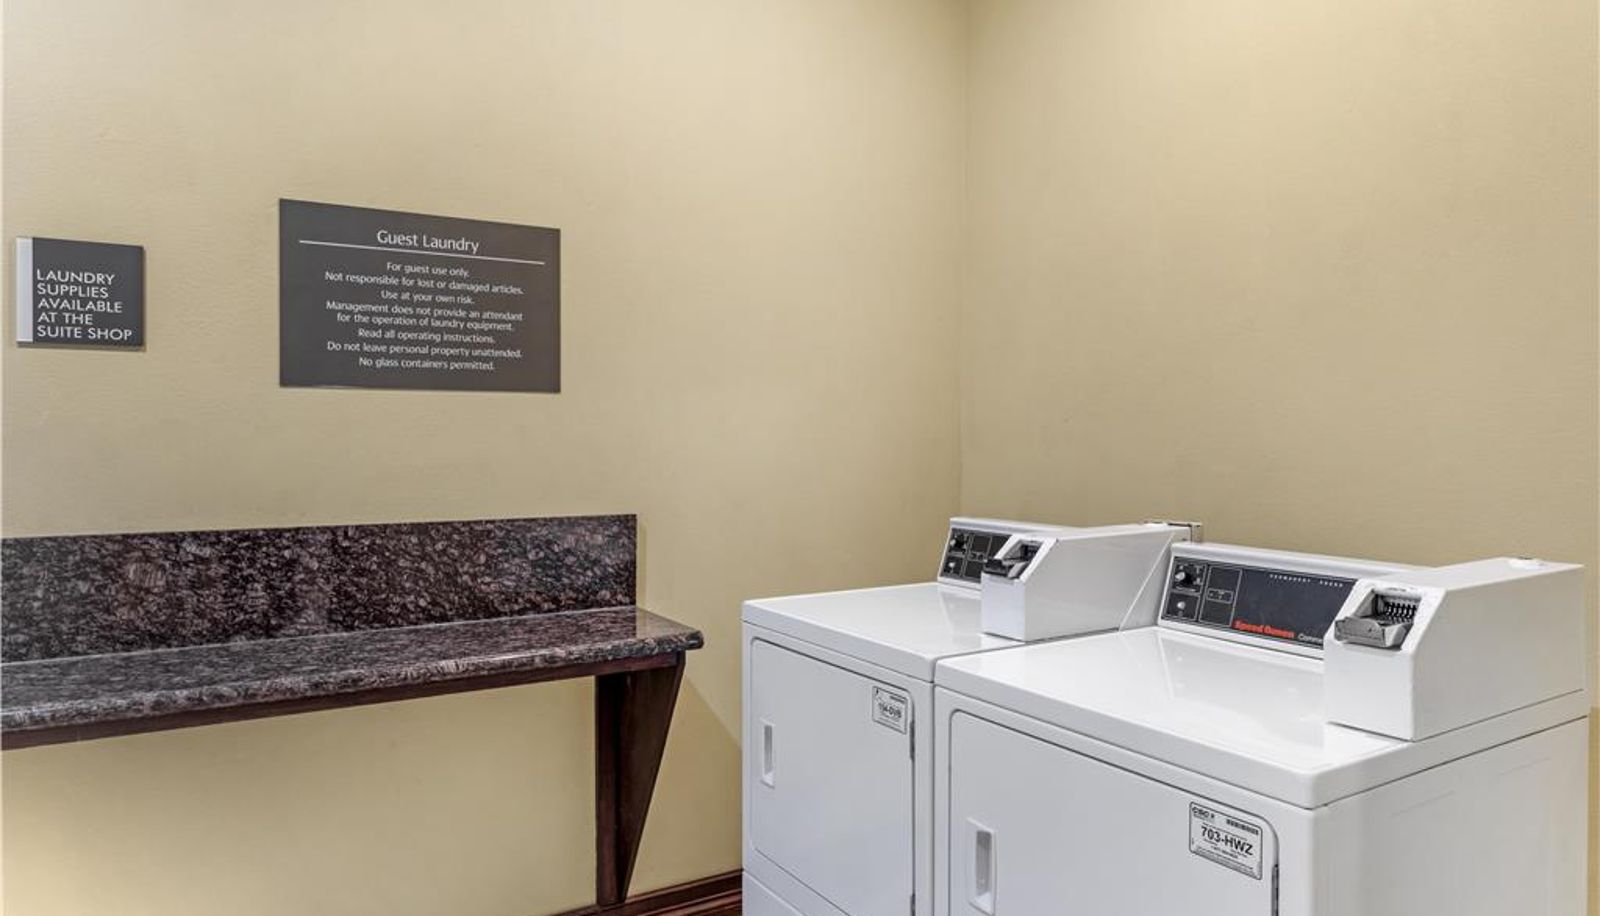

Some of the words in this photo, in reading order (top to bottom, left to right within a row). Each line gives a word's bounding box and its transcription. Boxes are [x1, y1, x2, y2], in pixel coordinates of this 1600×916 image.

[377, 229, 418, 247] Guest
[423, 234, 479, 255] Laundry
[387, 262, 401, 272] For
[404, 265, 429, 274] guest
[432, 267, 447, 276] use
[37, 269, 115, 286] LAUNDRY
[325, 270, 343, 281] Not
[346, 274, 399, 285] responsible
[401, 277, 415, 286] for
[417, 278, 434, 288] lost
[436, 281, 446, 289] or
[448, 281, 490, 293] damaged
[37, 283, 109, 299] SUPPLIES
[380, 290, 398, 299] Use
[401, 292, 410, 300] at
[412, 293, 433, 303] your
[435, 295, 455, 303] own
[38, 298, 123, 313] AVAILABLE
[326, 300, 388, 313] Management
[391, 305, 414, 315] does
[416, 307, 431, 316] not
[433, 308, 467, 318] provide
[469, 311, 480, 319] an
[481, 311, 523, 321] attendant
[38, 312, 58, 324] AT
[63, 313, 93, 325] THE
[336, 312, 351, 323] for
[354, 314, 370, 323] the
[371, 316, 417, 326] operation
[418, 317, 429, 326] of
[431, 318, 464, 330] laundry
[37, 325, 82, 339] SUITE
[88, 327, 132, 341] SHOP
[358, 328, 382, 338] Read
[384, 329, 396, 339] all
[397, 331, 441, 342] operating
[327, 340, 342, 351] Do
[343, 343, 360, 351] not
[363, 342, 387, 352] leave
[389, 344, 429, 354] personal
[431, 348, 469, 357] property
[359, 357, 373, 366] No
[375, 357, 399, 368] glass
[401, 359, 448, 369] containers
[1201, 826, 1253, 856] 703-HWZ
